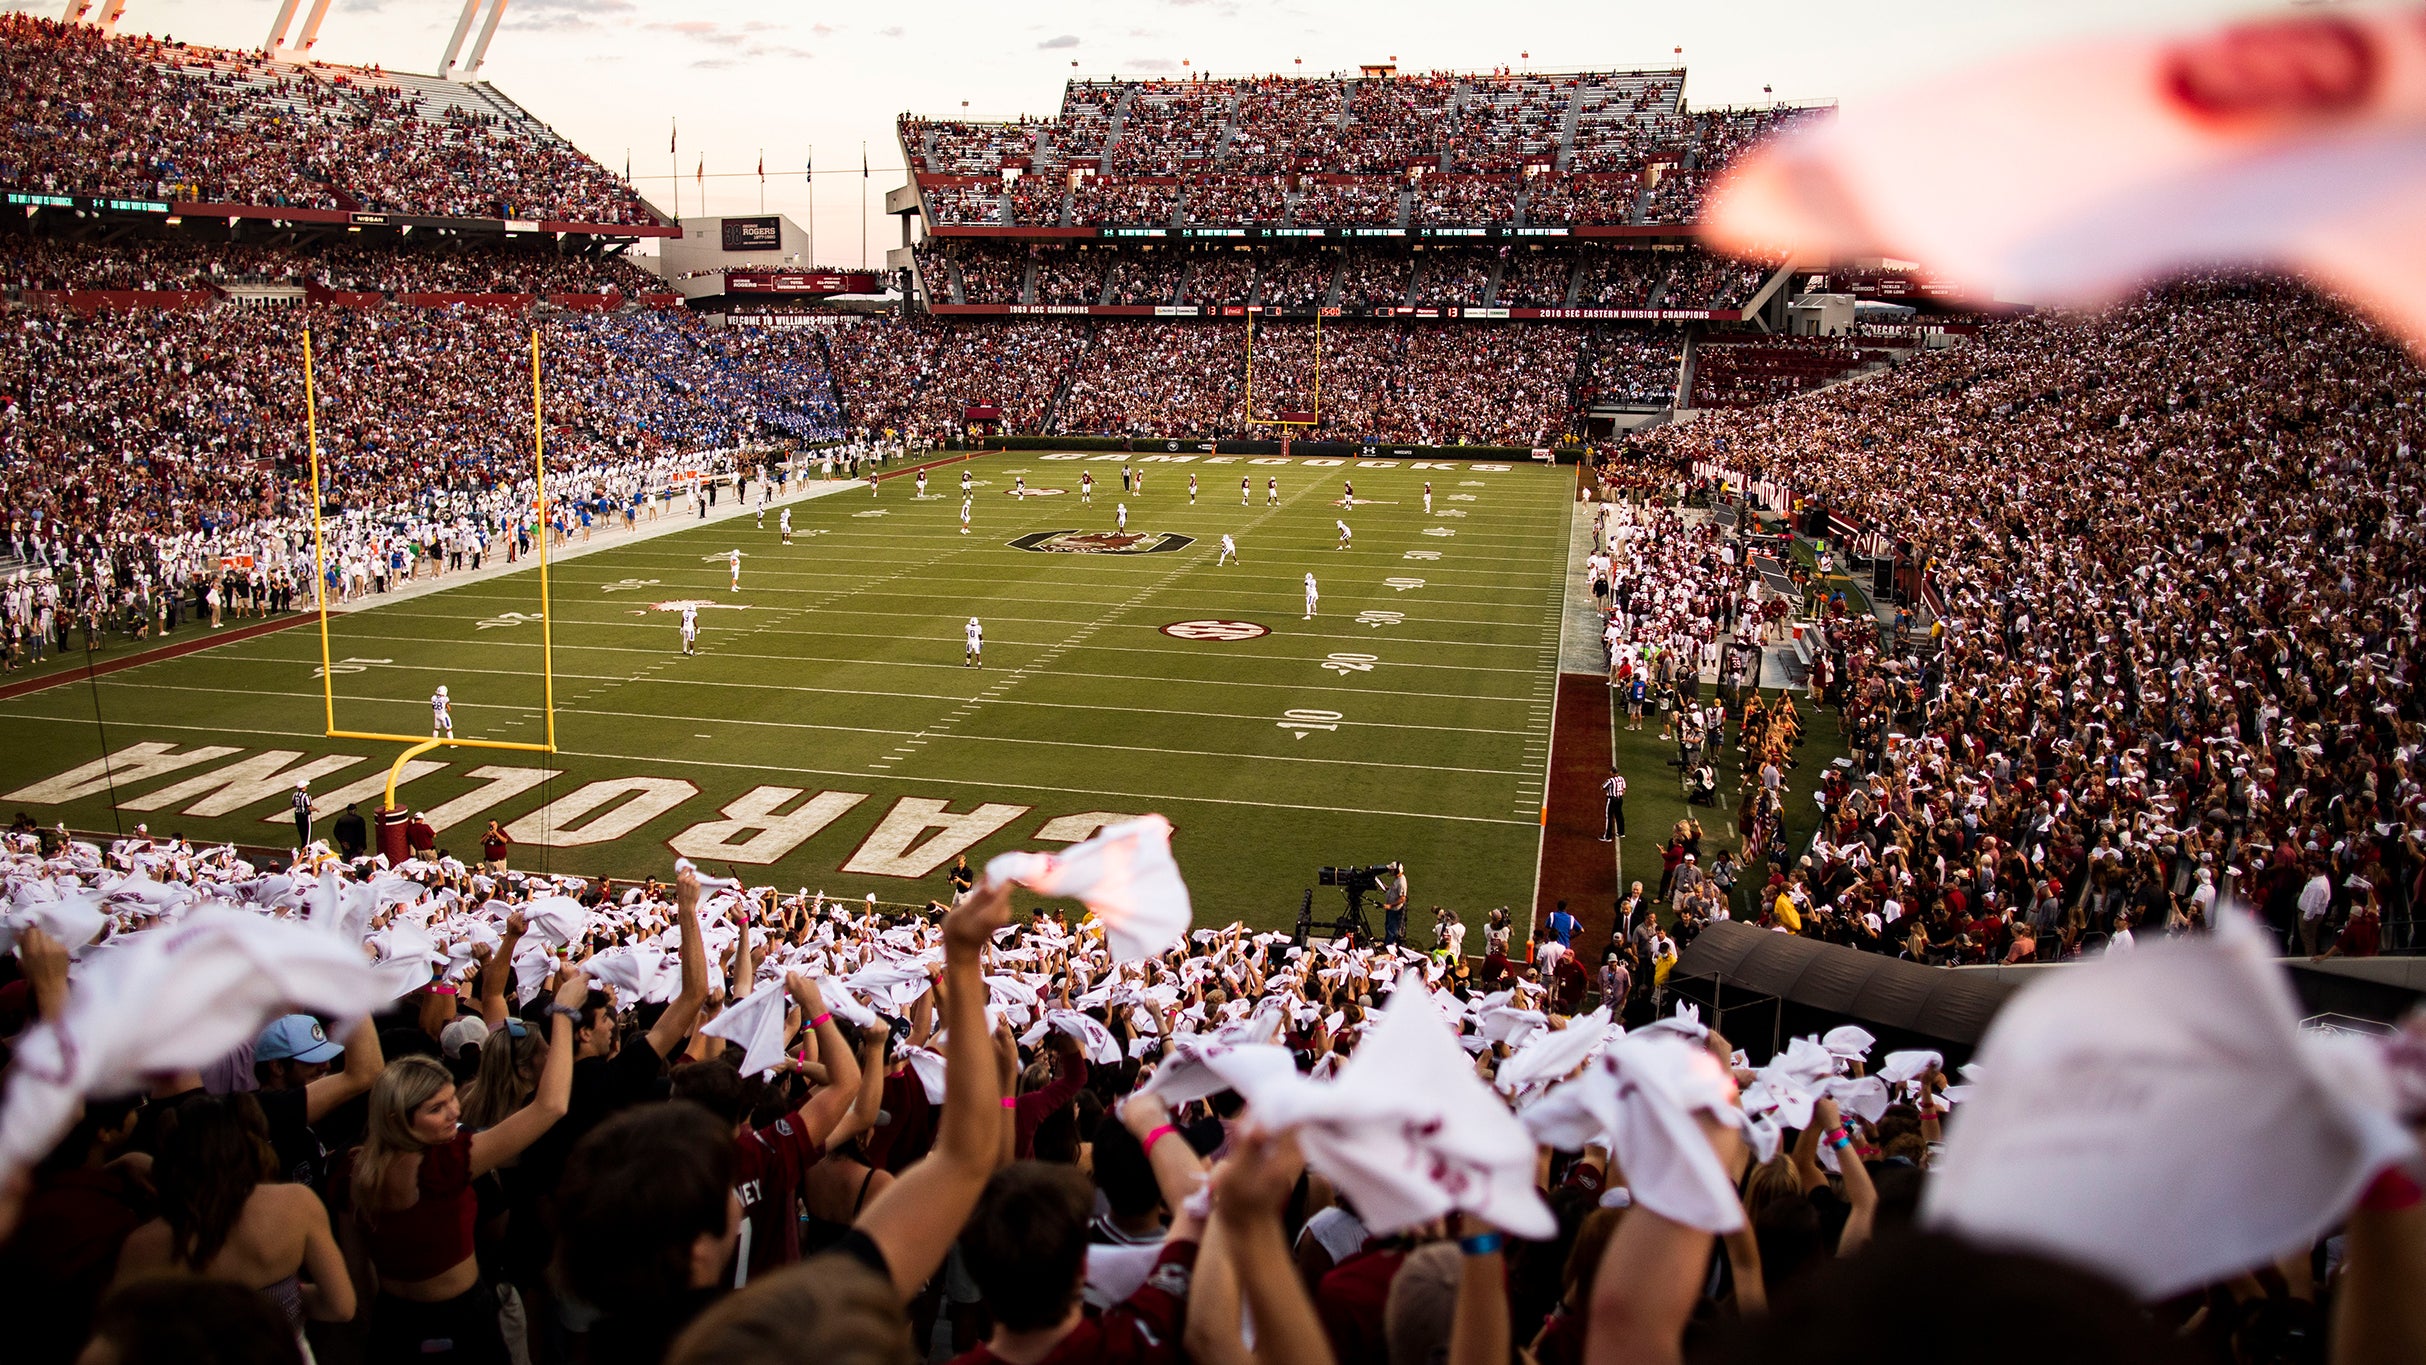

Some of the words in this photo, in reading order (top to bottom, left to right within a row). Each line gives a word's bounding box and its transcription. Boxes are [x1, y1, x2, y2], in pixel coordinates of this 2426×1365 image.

[743, 228, 776, 236] ROGERS
[1207, 306, 1216, 315] 13
[1321, 308, 1340, 316] 15:00
[1448, 308, 1458, 317] 13
[727, 316, 760, 325] WELCOME
[762, 315, 772, 325] TO
[1038, 453, 1514, 472] GAMECOCKS
[1355, 610, 1405, 624] 30
[1321, 653, 1378, 672] 20
[1732, 660, 1741, 668] 39
[432, 701, 443, 710] 28
[1276, 709, 1344, 732] 10
